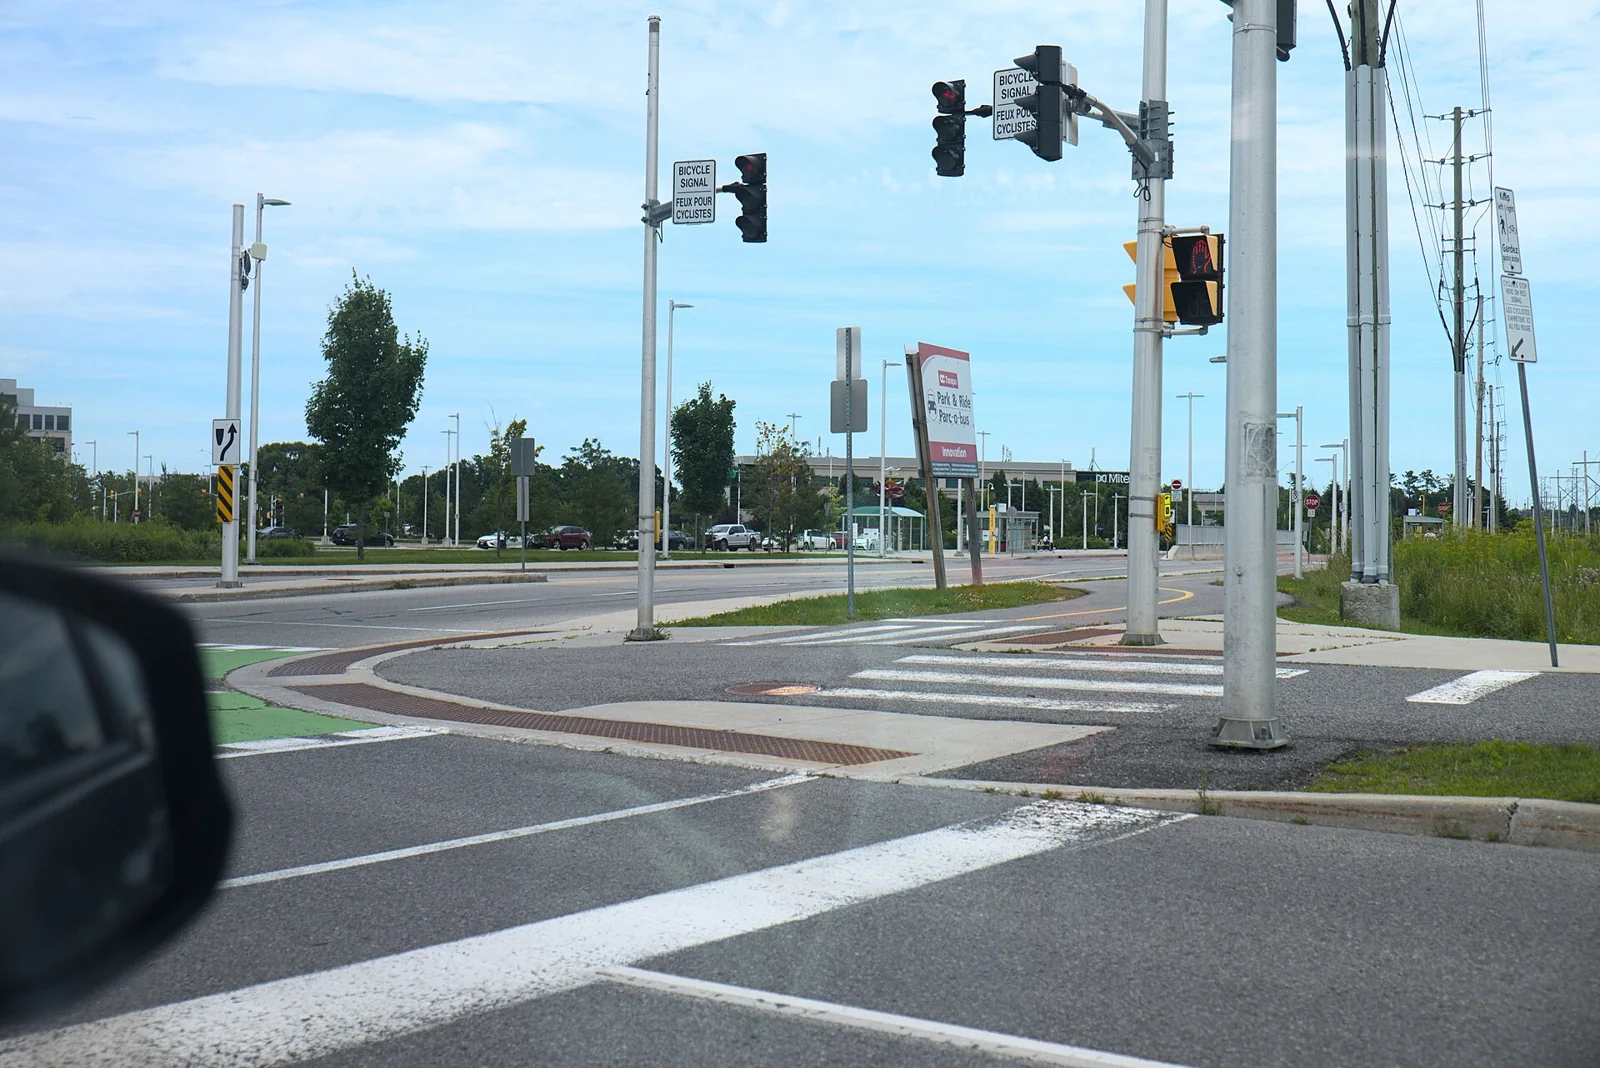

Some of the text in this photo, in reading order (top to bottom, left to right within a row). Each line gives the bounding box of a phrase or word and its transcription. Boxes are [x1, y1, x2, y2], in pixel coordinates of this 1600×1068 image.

[1000, 73, 1034, 86] BICYCLE
[1001, 86, 1031, 99] SIGNAL
[997, 109, 1031, 121] FEUX POU
[997, 120, 1037, 134] CYCLISTES
[679, 165, 710, 175] BICYCLE
[680, 178, 708, 188] SIGNAL
[676, 196, 712, 207] FEUX POUR
[676, 209, 712, 219] CYCLISTES
[937, 391, 971, 409] Park & Ride
[938, 409, 970, 425] Parc-o-bus
[942, 446, 967, 458] Innovation
[1108, 473, 1129, 484] Mite
[1305, 498, 1319, 506] STOP
